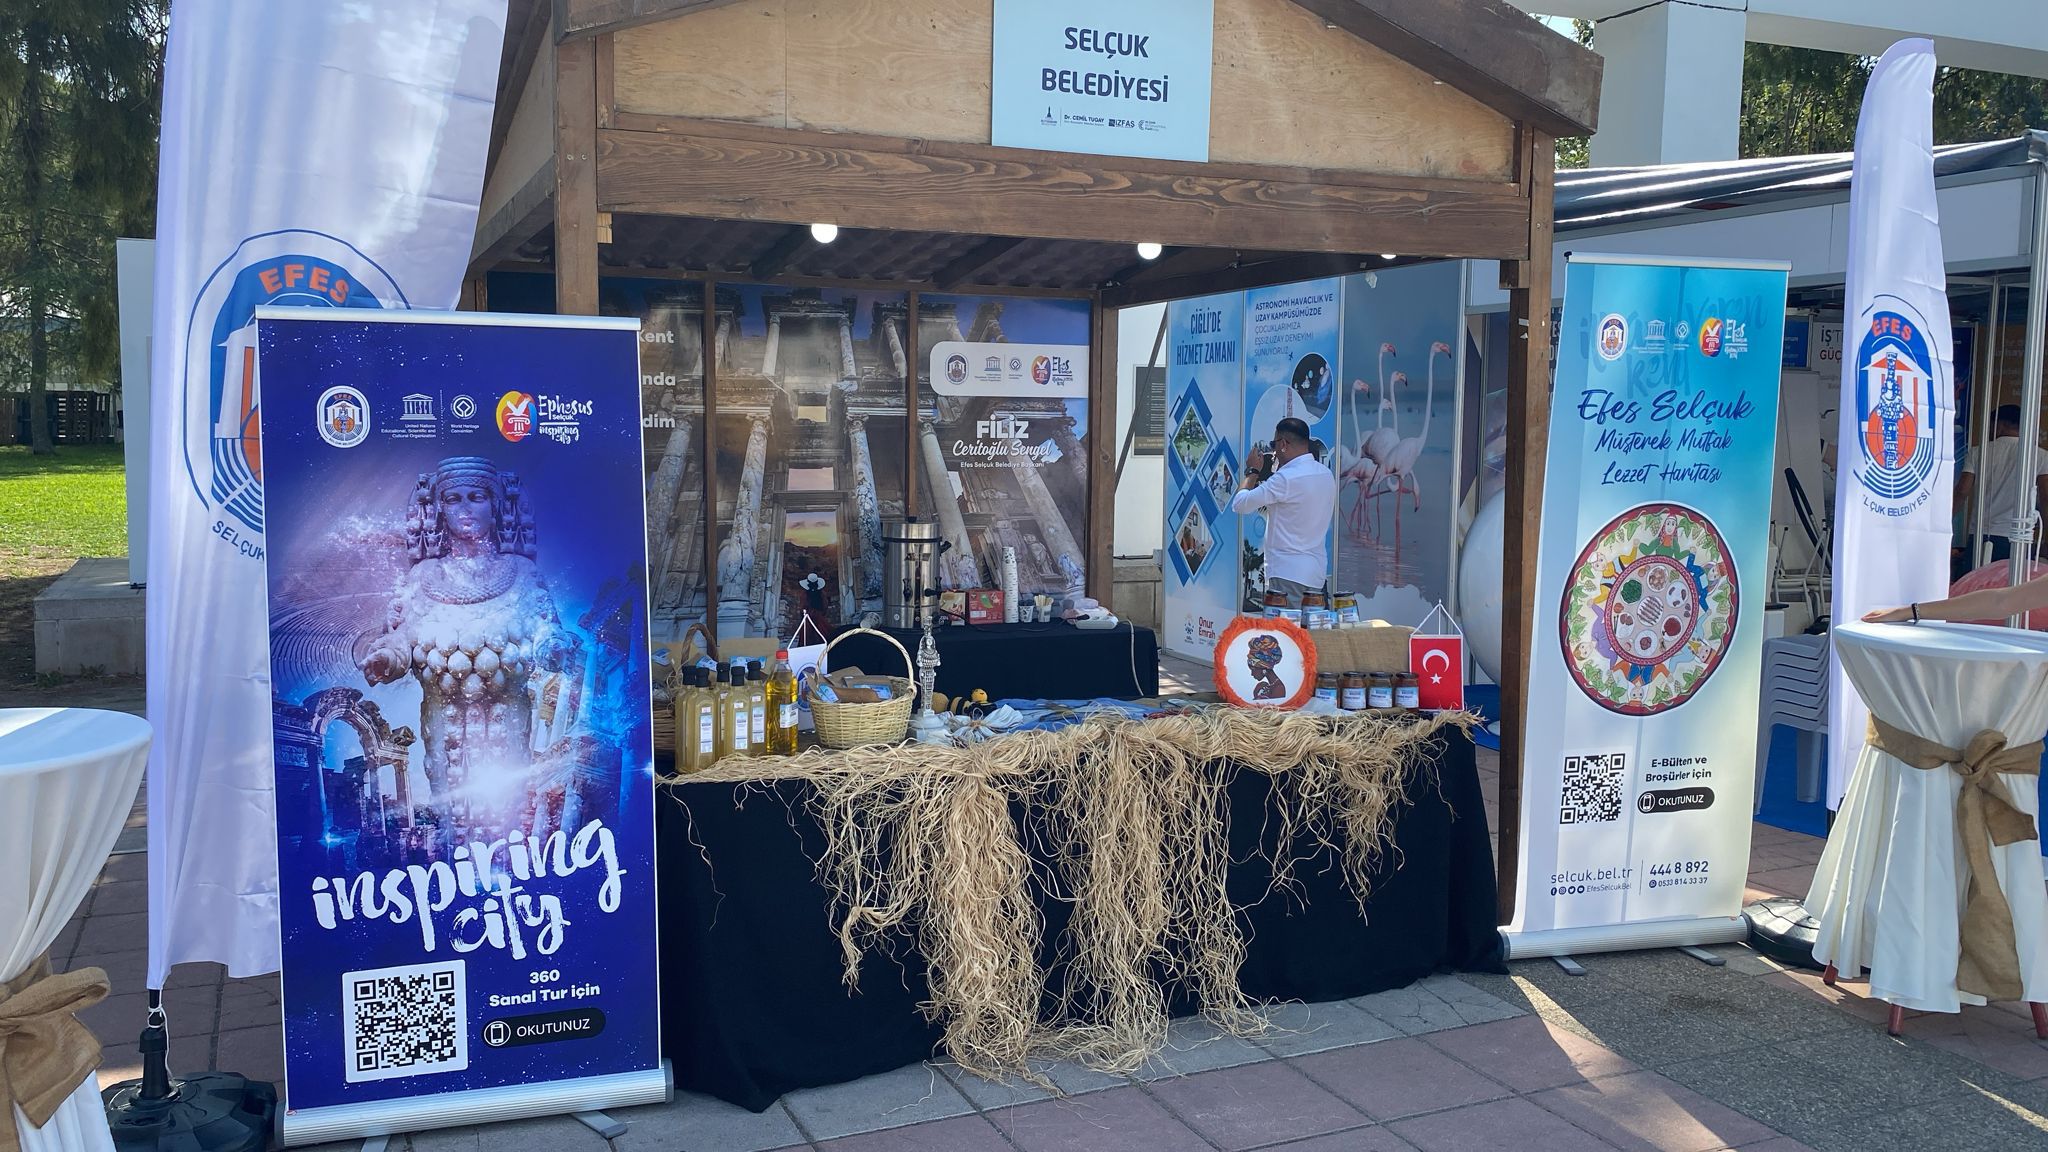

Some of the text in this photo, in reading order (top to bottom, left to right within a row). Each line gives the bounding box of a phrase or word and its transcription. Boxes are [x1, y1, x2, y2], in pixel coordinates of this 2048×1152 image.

[1064, 27, 1149, 59] SELÇUK
[1041, 68, 1168, 102] BELEDİYESİ
[258, 264, 349, 304] EFES
[1255, 293, 1333, 311] ASTRONOMİ HAVACILIK VE
[1191, 307, 1222, 339] ÇİĞLİ'DE
[1255, 313, 1270, 322] UZAY
[1871, 316, 1912, 342] EFES
[1177, 340, 1236, 365] HİZMET ZAMANI
[538, 394, 593, 420] Ephesus
[1577, 389, 1755, 425] Efes Selçuk
[539, 425, 580, 441] inspiring
[976, 414, 1029, 439] FİLİZ
[952, 439, 1009, 461] Ceritoğlu
[1594, 428, 1733, 455] Müşterek Mutfak
[974, 461, 994, 469] Selçuk
[995, 461, 1020, 469] Belediye
[1601, 461, 1659, 485] Lezzet
[212, 520, 265, 561] SELÇUK
[1651, 757, 1692, 768] E-Bülten
[1645, 768, 1712, 783] Broşürler için
[1658, 794, 1704, 806] OKUTUNUZ
[1551, 867, 1633, 884] selcuk.bel.tr
[1650, 860, 1709, 876] 444 8 892
[312, 818, 627, 952] inspiring
[1586, 882, 1632, 892] EfesSelcukBel
[1658, 879, 1673, 887] 0533
[1699, 876, 1708, 884] 37
[450, 873, 571, 960] city
[529, 969, 561, 984] 360
[489, 983, 600, 1007] Sanal Tur için
[516, 1018, 591, 1037] OKUTUNUZ
